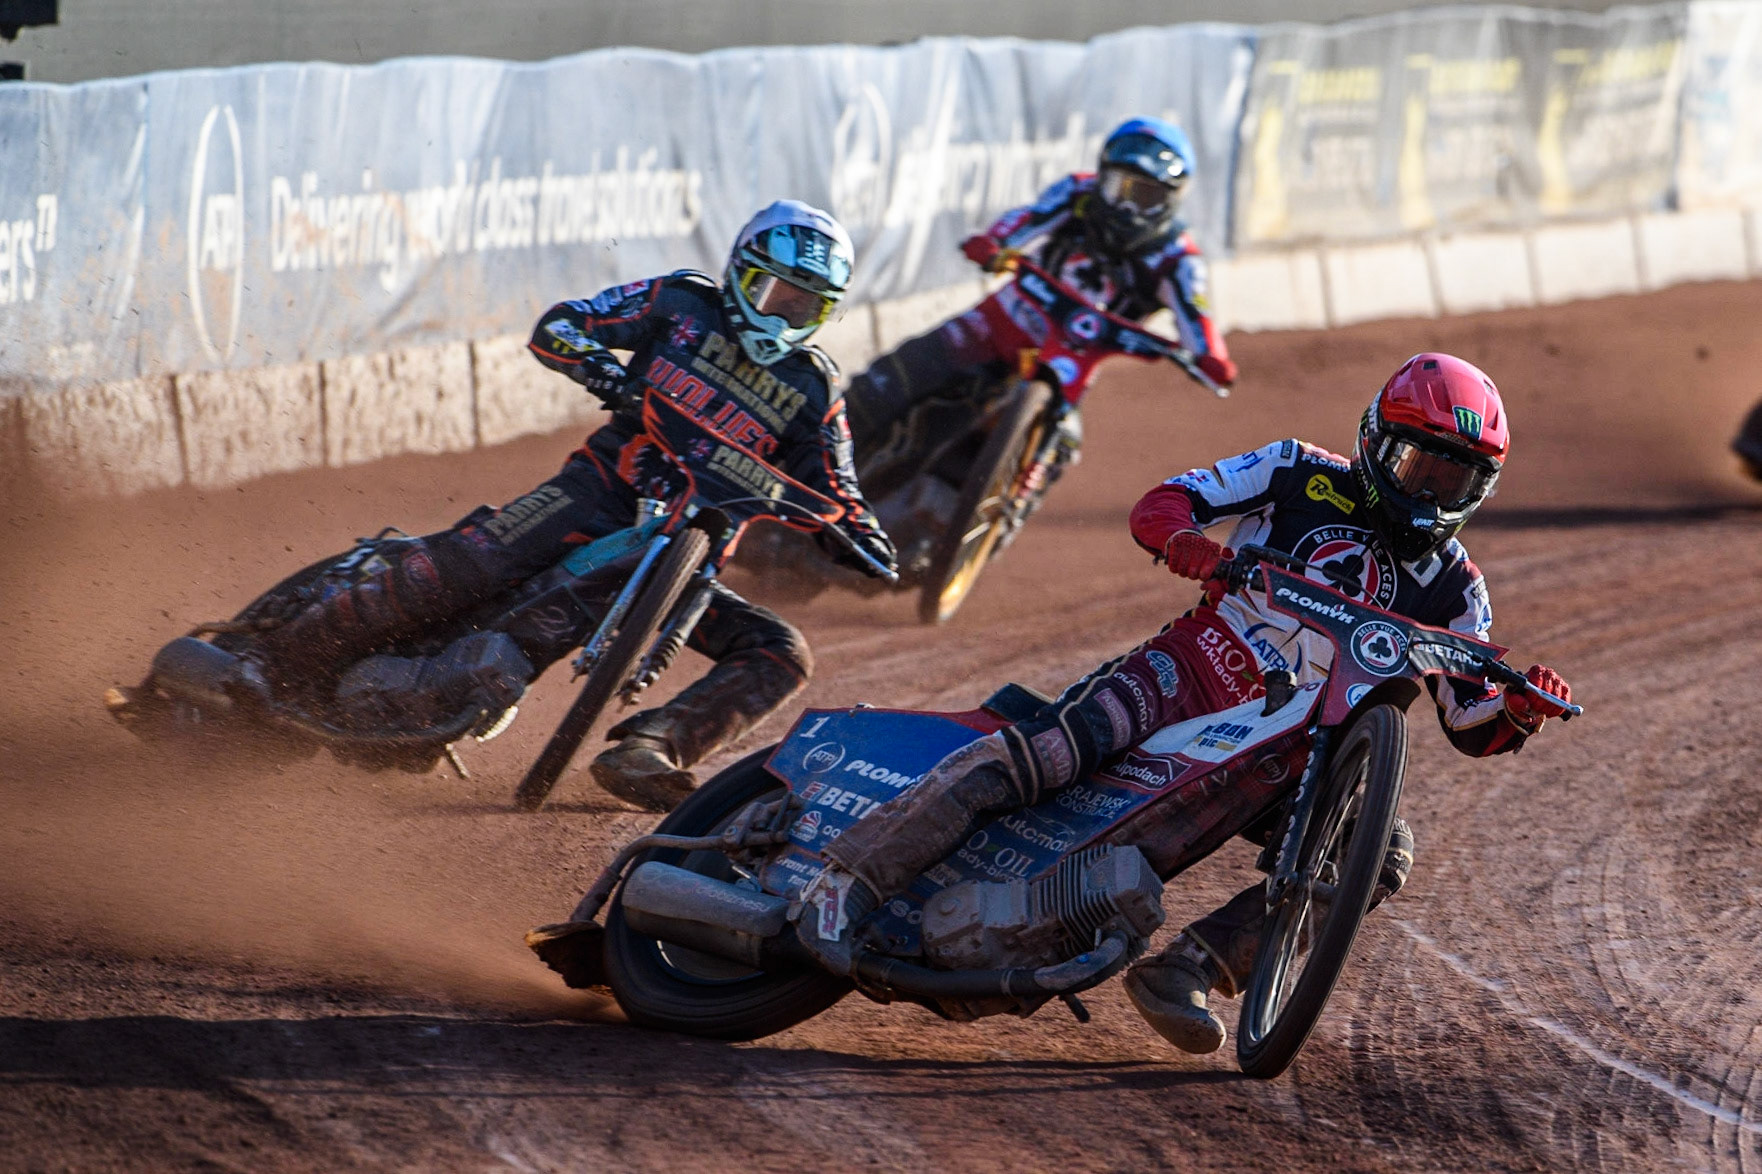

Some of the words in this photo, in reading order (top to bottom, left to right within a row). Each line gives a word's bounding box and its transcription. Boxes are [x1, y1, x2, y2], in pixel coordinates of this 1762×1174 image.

[1312, 528, 1356, 546] BELLE
[1379, 563, 1394, 600] ACES
[799, 715, 831, 739] 1
